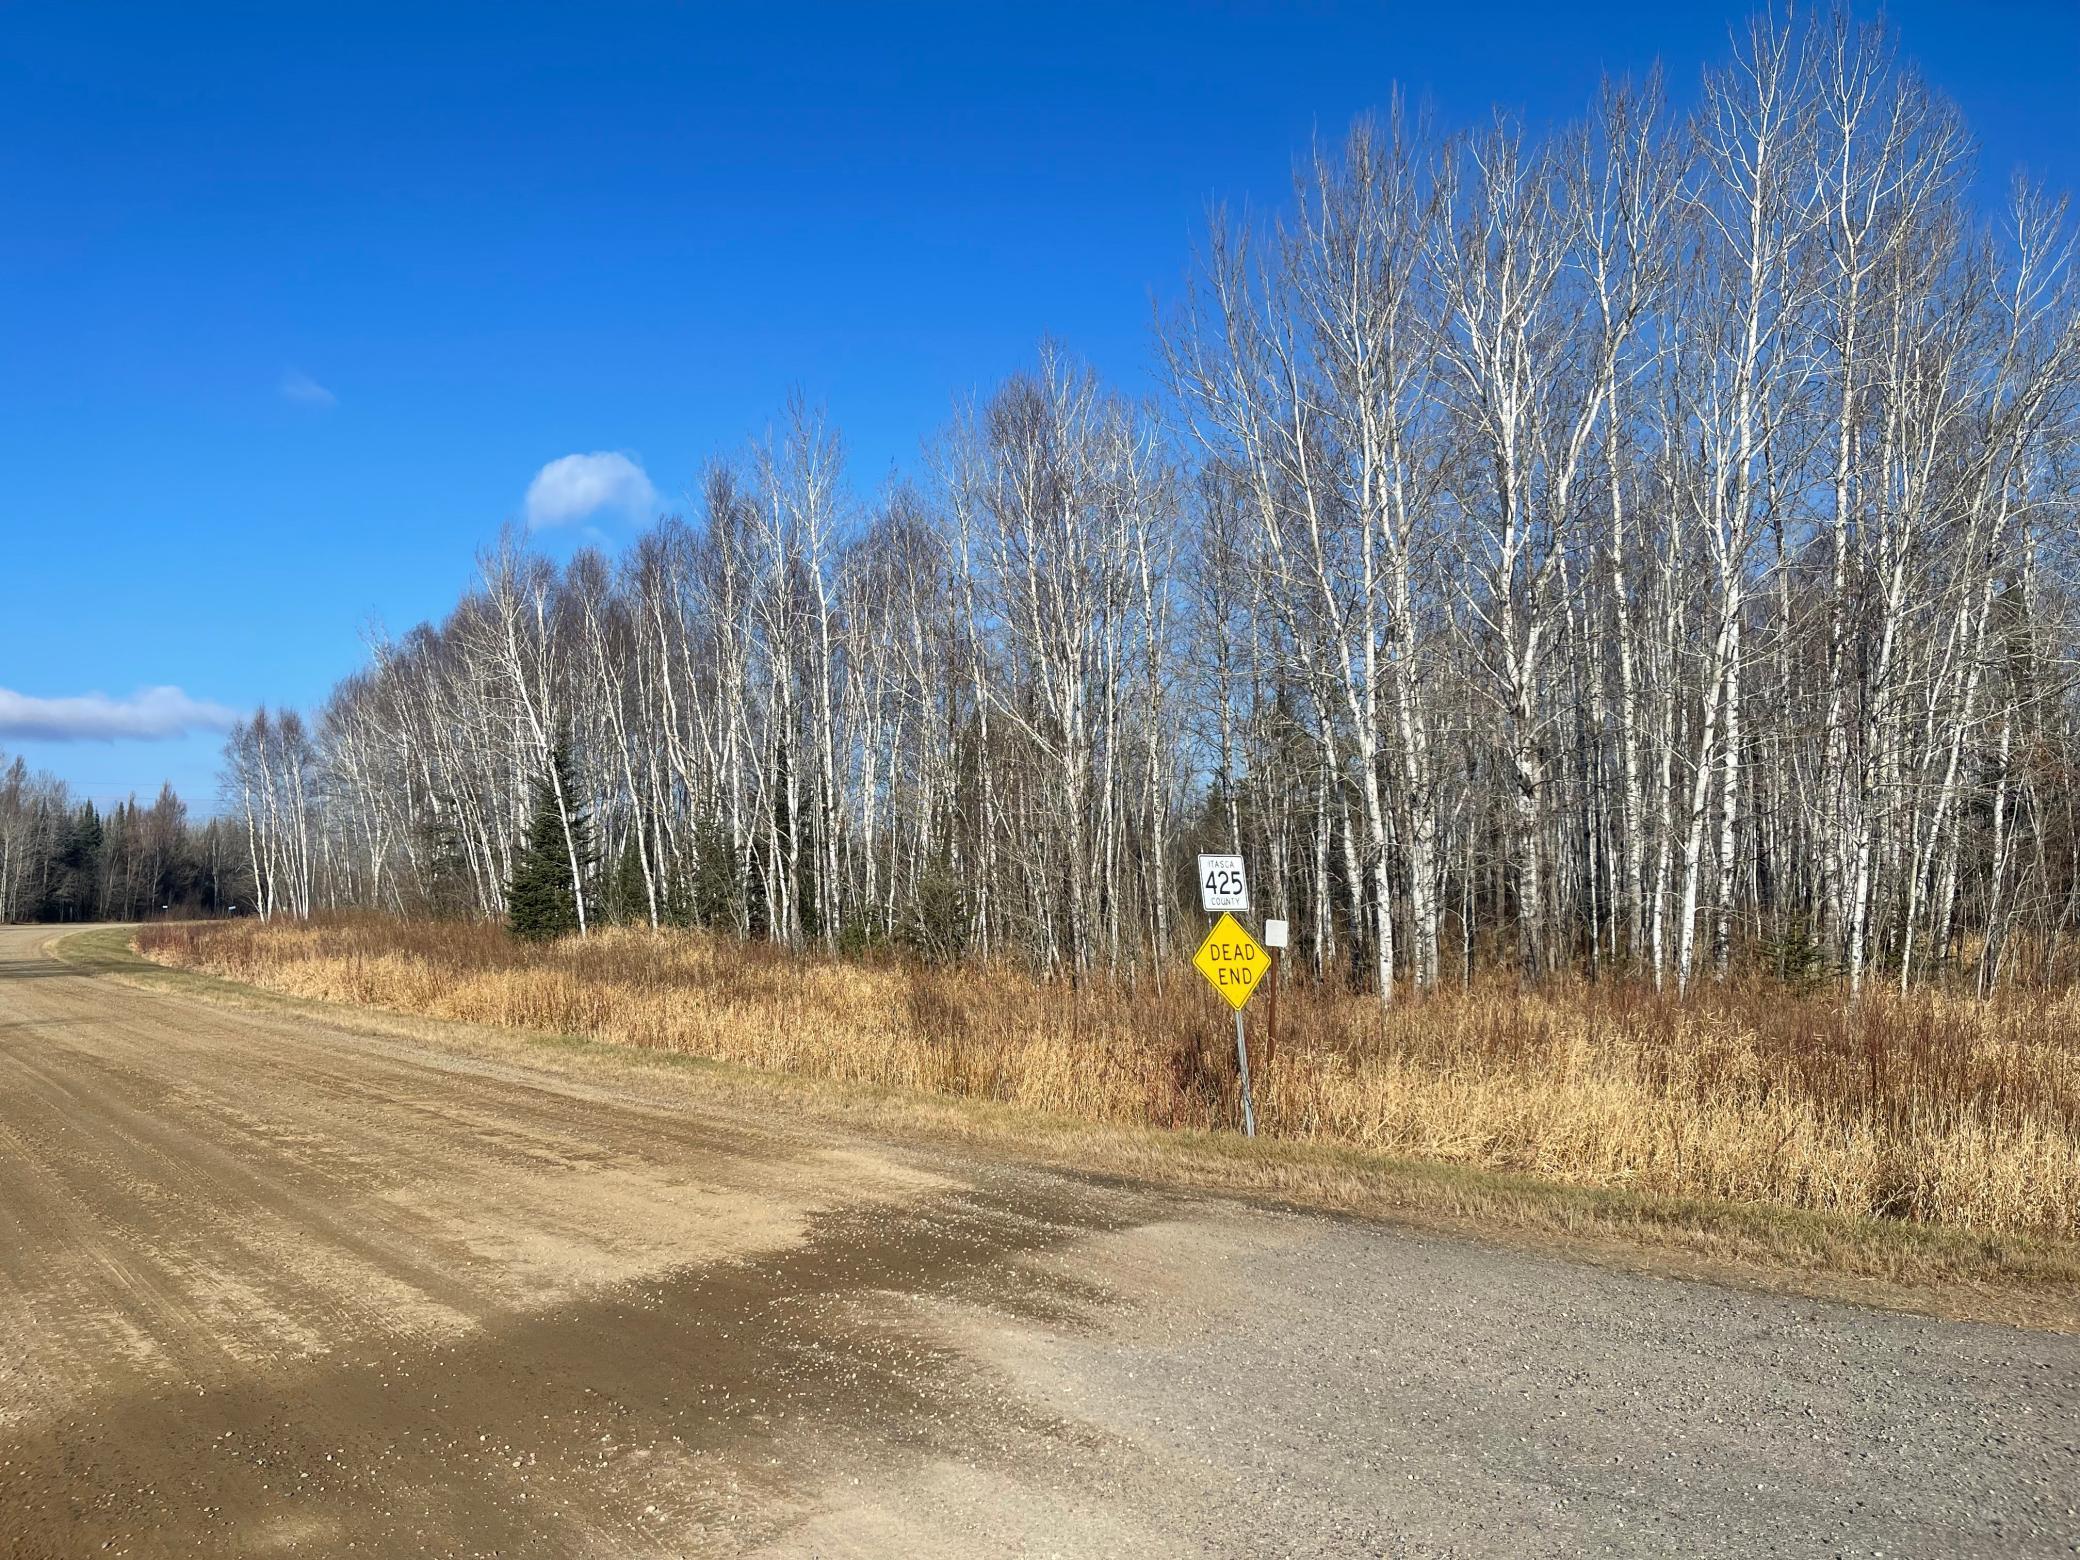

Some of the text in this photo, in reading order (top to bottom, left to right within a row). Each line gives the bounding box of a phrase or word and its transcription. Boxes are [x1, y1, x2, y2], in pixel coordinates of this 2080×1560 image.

[1208, 860, 1235, 869] ITASCA
[1205, 870, 1243, 895] 425
[1211, 897, 1240, 906] COUNTY
[1210, 944, 1255, 961] DEAD
[1218, 967, 1252, 985] END
